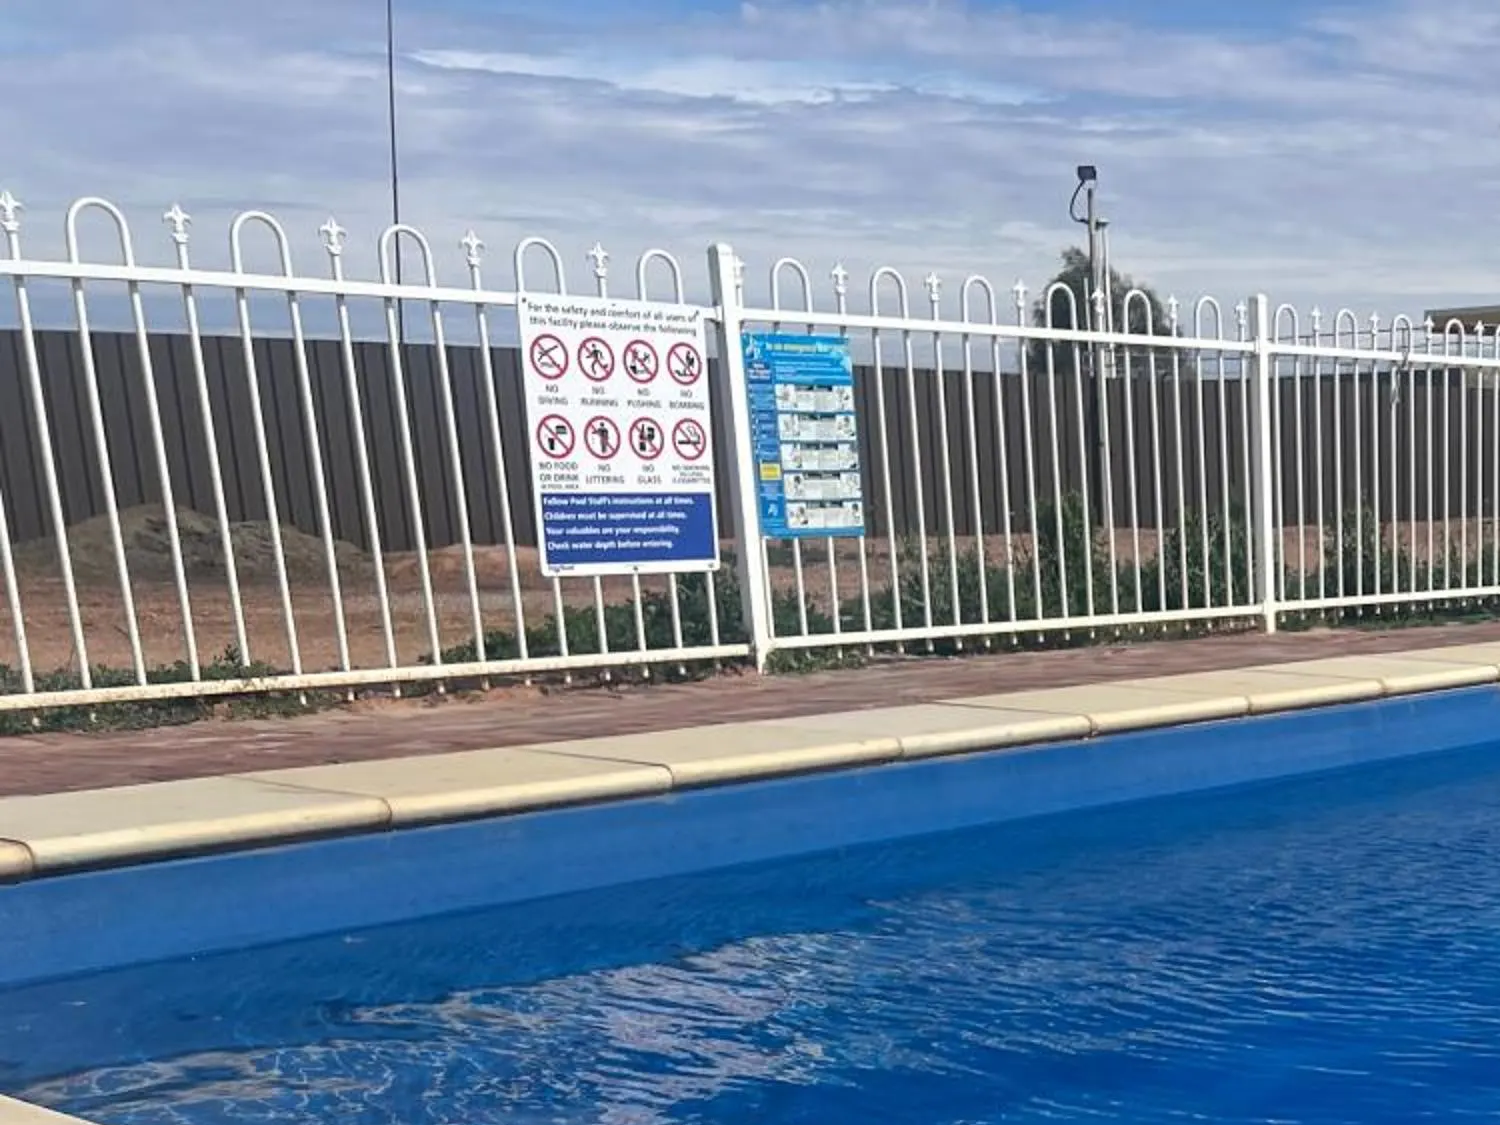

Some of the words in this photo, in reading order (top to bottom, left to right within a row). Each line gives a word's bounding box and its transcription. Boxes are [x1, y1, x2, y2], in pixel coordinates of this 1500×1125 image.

[528, 302, 542, 312] For
[544, 303, 558, 313] the
[561, 305, 587, 317] safety
[590, 307, 606, 317] and
[530, 317, 546, 326] this
[546, 384, 558, 393] NO
[592, 387, 605, 395] NO
[680, 390, 692, 398] NO
[539, 462, 552, 470] NO
[554, 462, 578, 470] FOOD
[540, 474, 552, 482] OR
